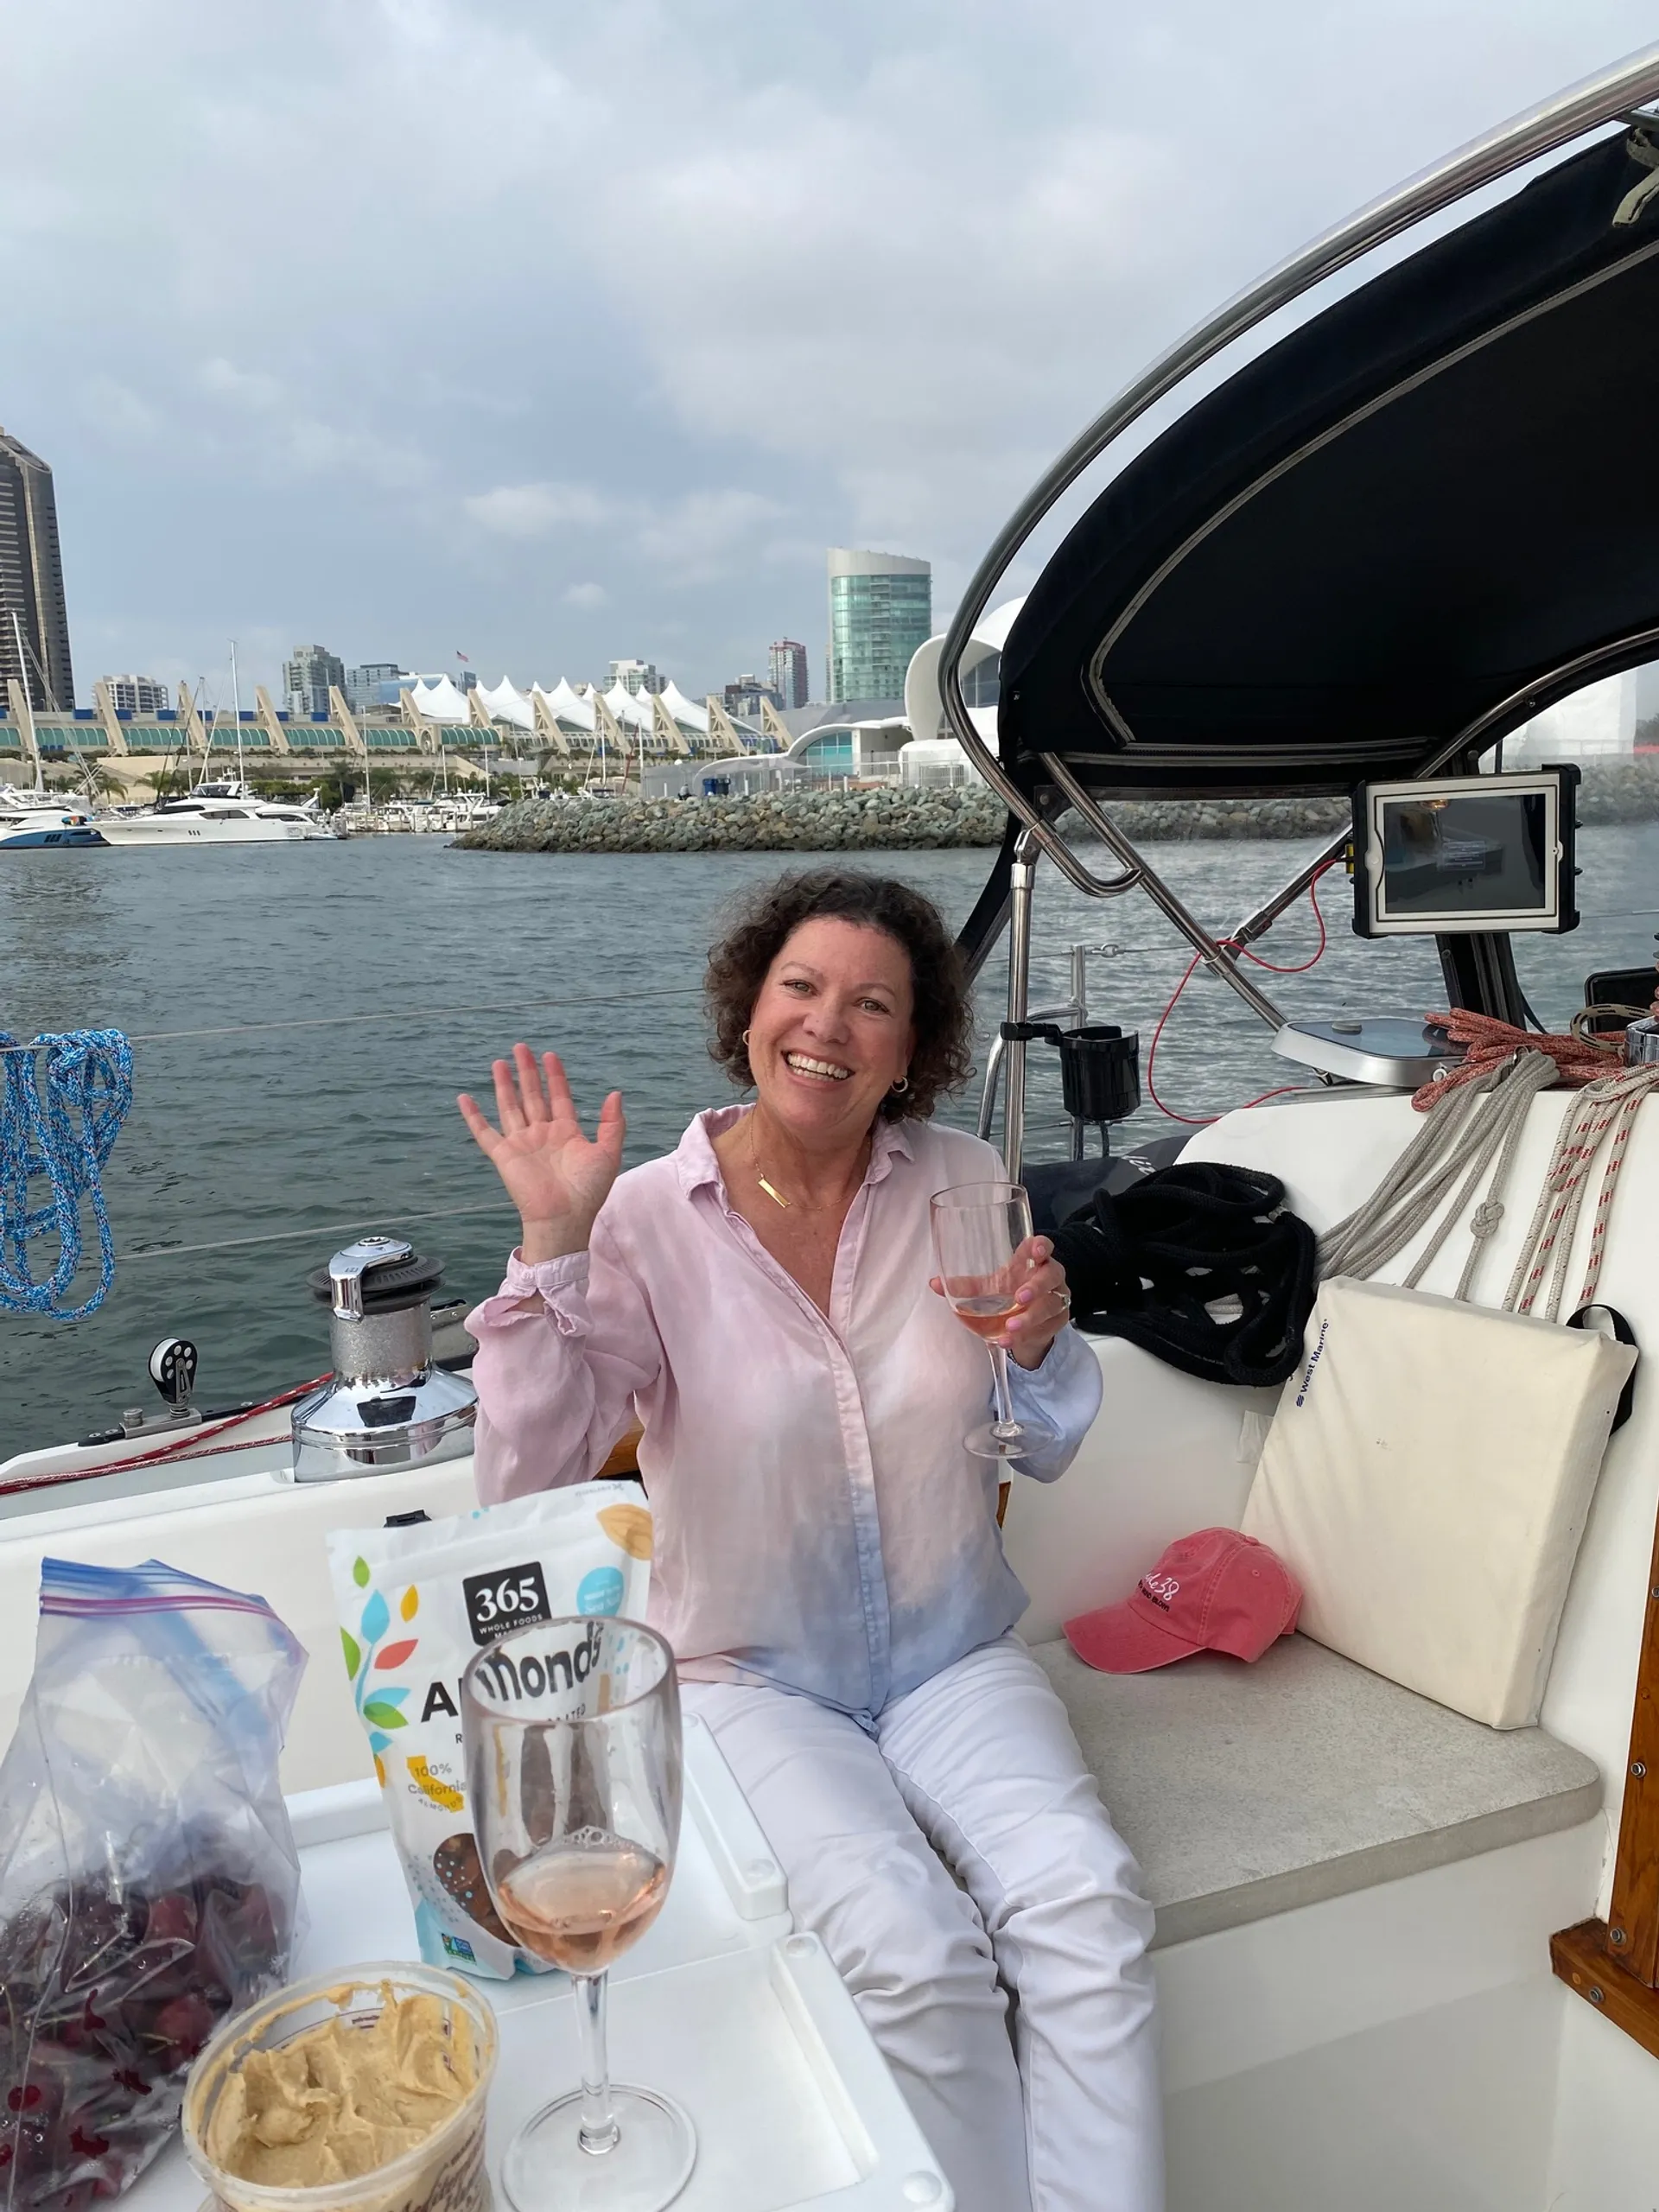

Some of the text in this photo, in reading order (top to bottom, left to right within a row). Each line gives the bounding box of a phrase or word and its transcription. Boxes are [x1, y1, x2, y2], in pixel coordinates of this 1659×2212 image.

[1300, 1322, 1329, 1393] West Marine
[474, 1576, 540, 1623] 365
[479, 1621, 511, 1636] WHOLE
[513, 1612, 543, 1627] FOODS
[421, 1620, 604, 1723] Amonds
[414, 1763, 453, 1777] 100%
[408, 1780, 467, 1796] California
